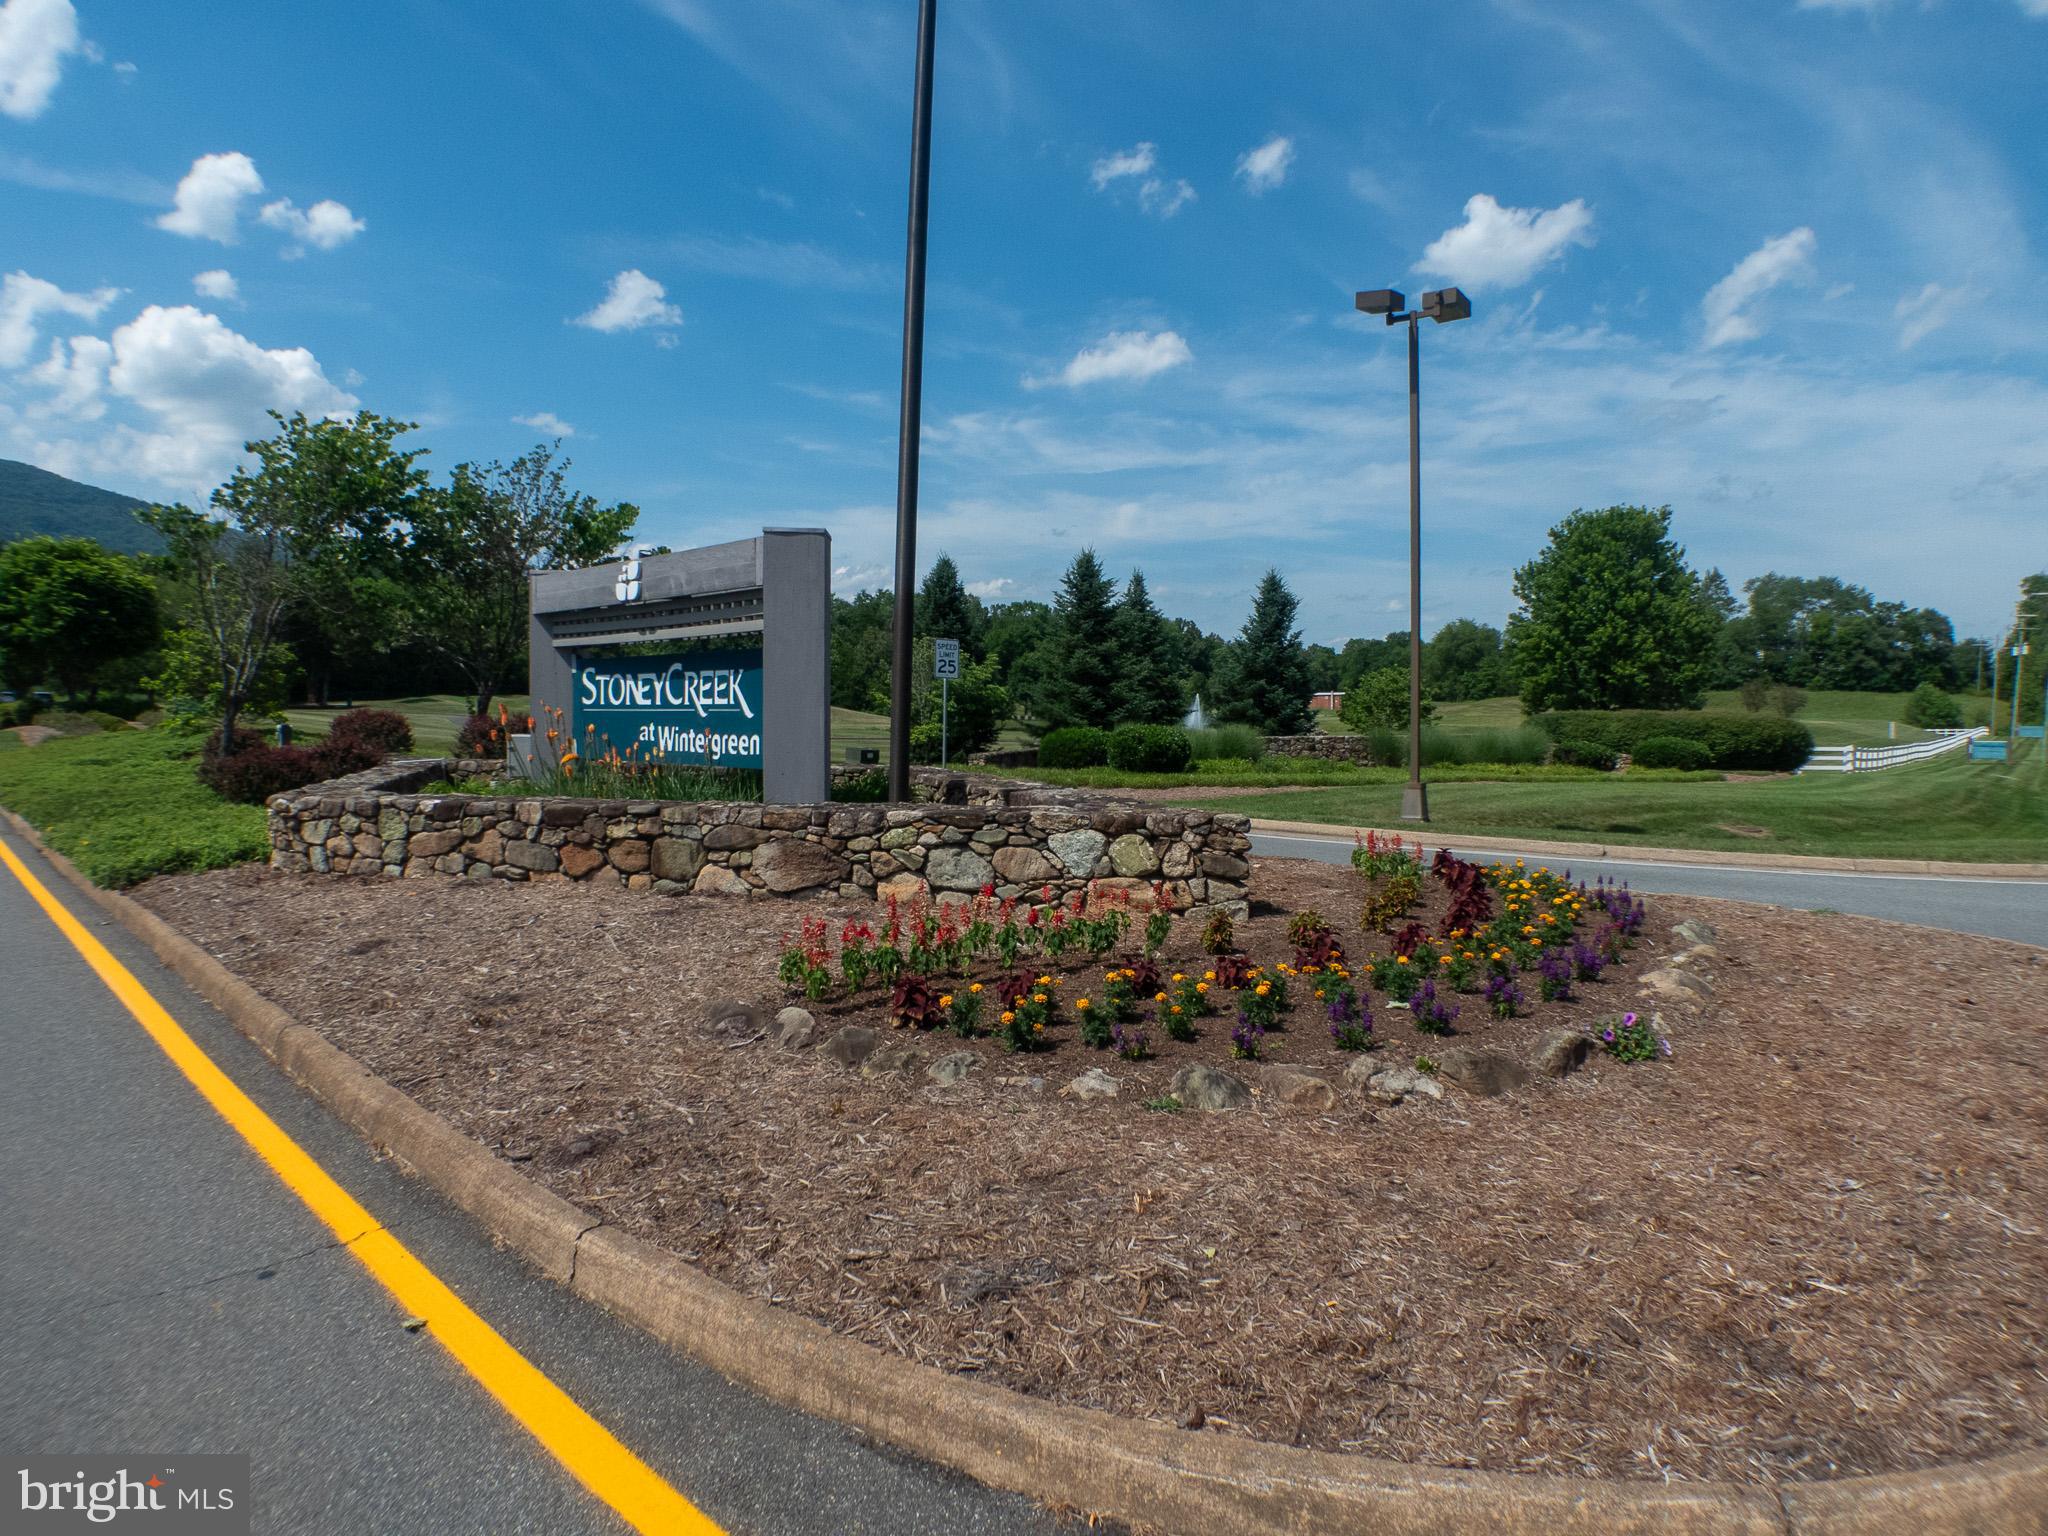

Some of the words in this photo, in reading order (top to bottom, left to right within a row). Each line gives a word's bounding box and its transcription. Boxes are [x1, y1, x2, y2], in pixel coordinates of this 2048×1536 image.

[937, 659, 957, 674] 25
[639, 721, 656, 742] at
[657, 725, 760, 760] Wintergreen
